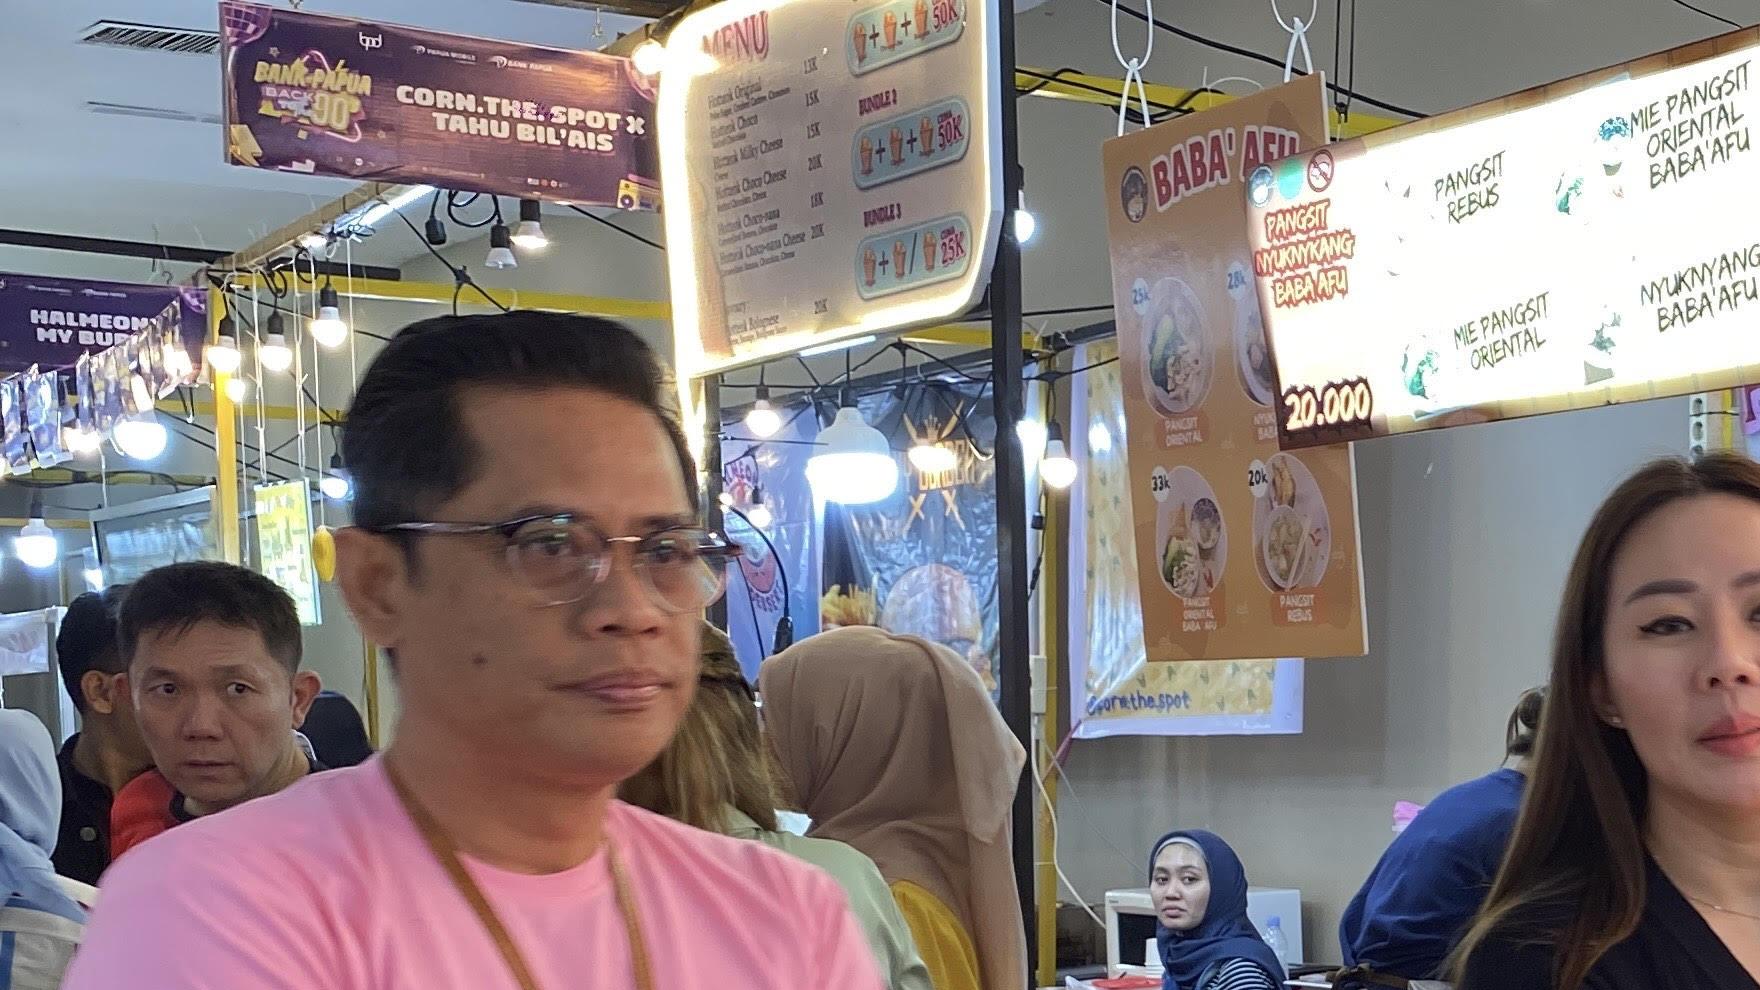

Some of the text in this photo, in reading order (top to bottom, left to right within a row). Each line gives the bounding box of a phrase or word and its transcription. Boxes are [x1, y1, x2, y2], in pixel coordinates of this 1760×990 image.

[703, 10, 769, 62] MENU
[1630, 59, 1752, 139] MIE PANGSIT
[433, 112, 614, 151] TAHU BIL'AIS
[1647, 100, 1745, 158] ORIENTAL
[1434, 149, 1506, 201] PANGSIT
[1266, 201, 1330, 240] PANGSIT
[1447, 183, 1500, 224] REBUS
[1256, 232, 1355, 273] NYUKNYKANG
[1273, 267, 1349, 307] BABA AFU
[30, 308, 157, 331] HALMEON
[37, 327, 72, 343] MY
[1454, 291, 1550, 351] MIE PANGSIT
[1471, 326, 1547, 371] ORIENTAL
[1285, 381, 1372, 433] 20.000
[1152, 474, 1171, 492] 33k
[1248, 468, 1269, 487] 20k
